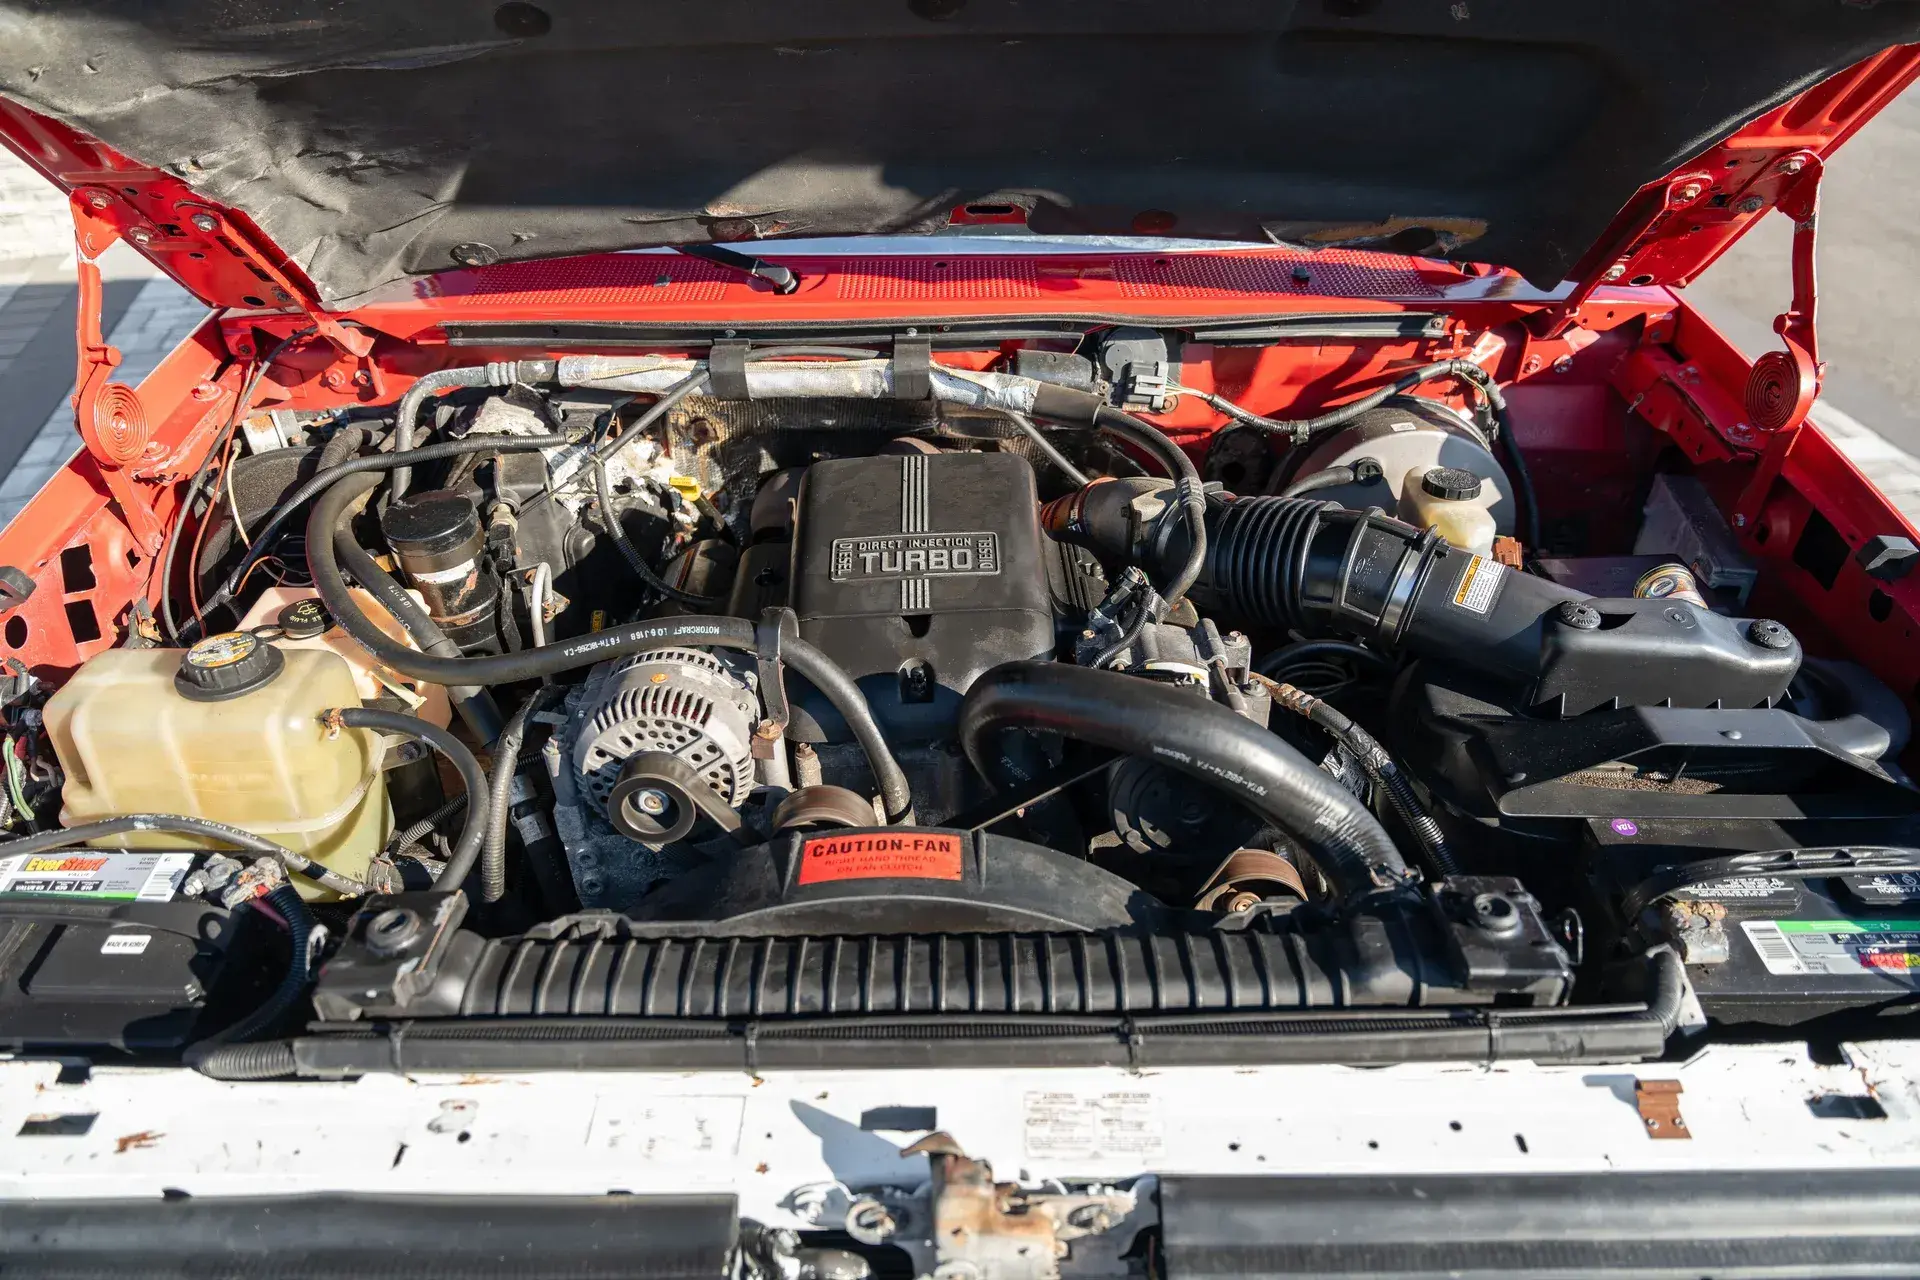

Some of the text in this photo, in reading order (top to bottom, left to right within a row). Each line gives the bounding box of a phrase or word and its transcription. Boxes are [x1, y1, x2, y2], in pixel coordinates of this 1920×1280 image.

[860, 537, 972, 551] DIRECT INJECTION
[837, 542, 852, 575] DIESEL
[977, 537, 992, 570] DIESEL
[859, 548, 973, 575] TURBO
[673, 625, 720, 636] MOTORCRAFT
[812, 838, 952, 858] CAUTION-FAN
[26, 857, 107, 872] EverStart
[860, 855, 890, 863] HAND
[895, 854, 937, 864] THREAD
[856, 864, 877, 872] FAN
[879, 863, 923, 872] CLUTCH
